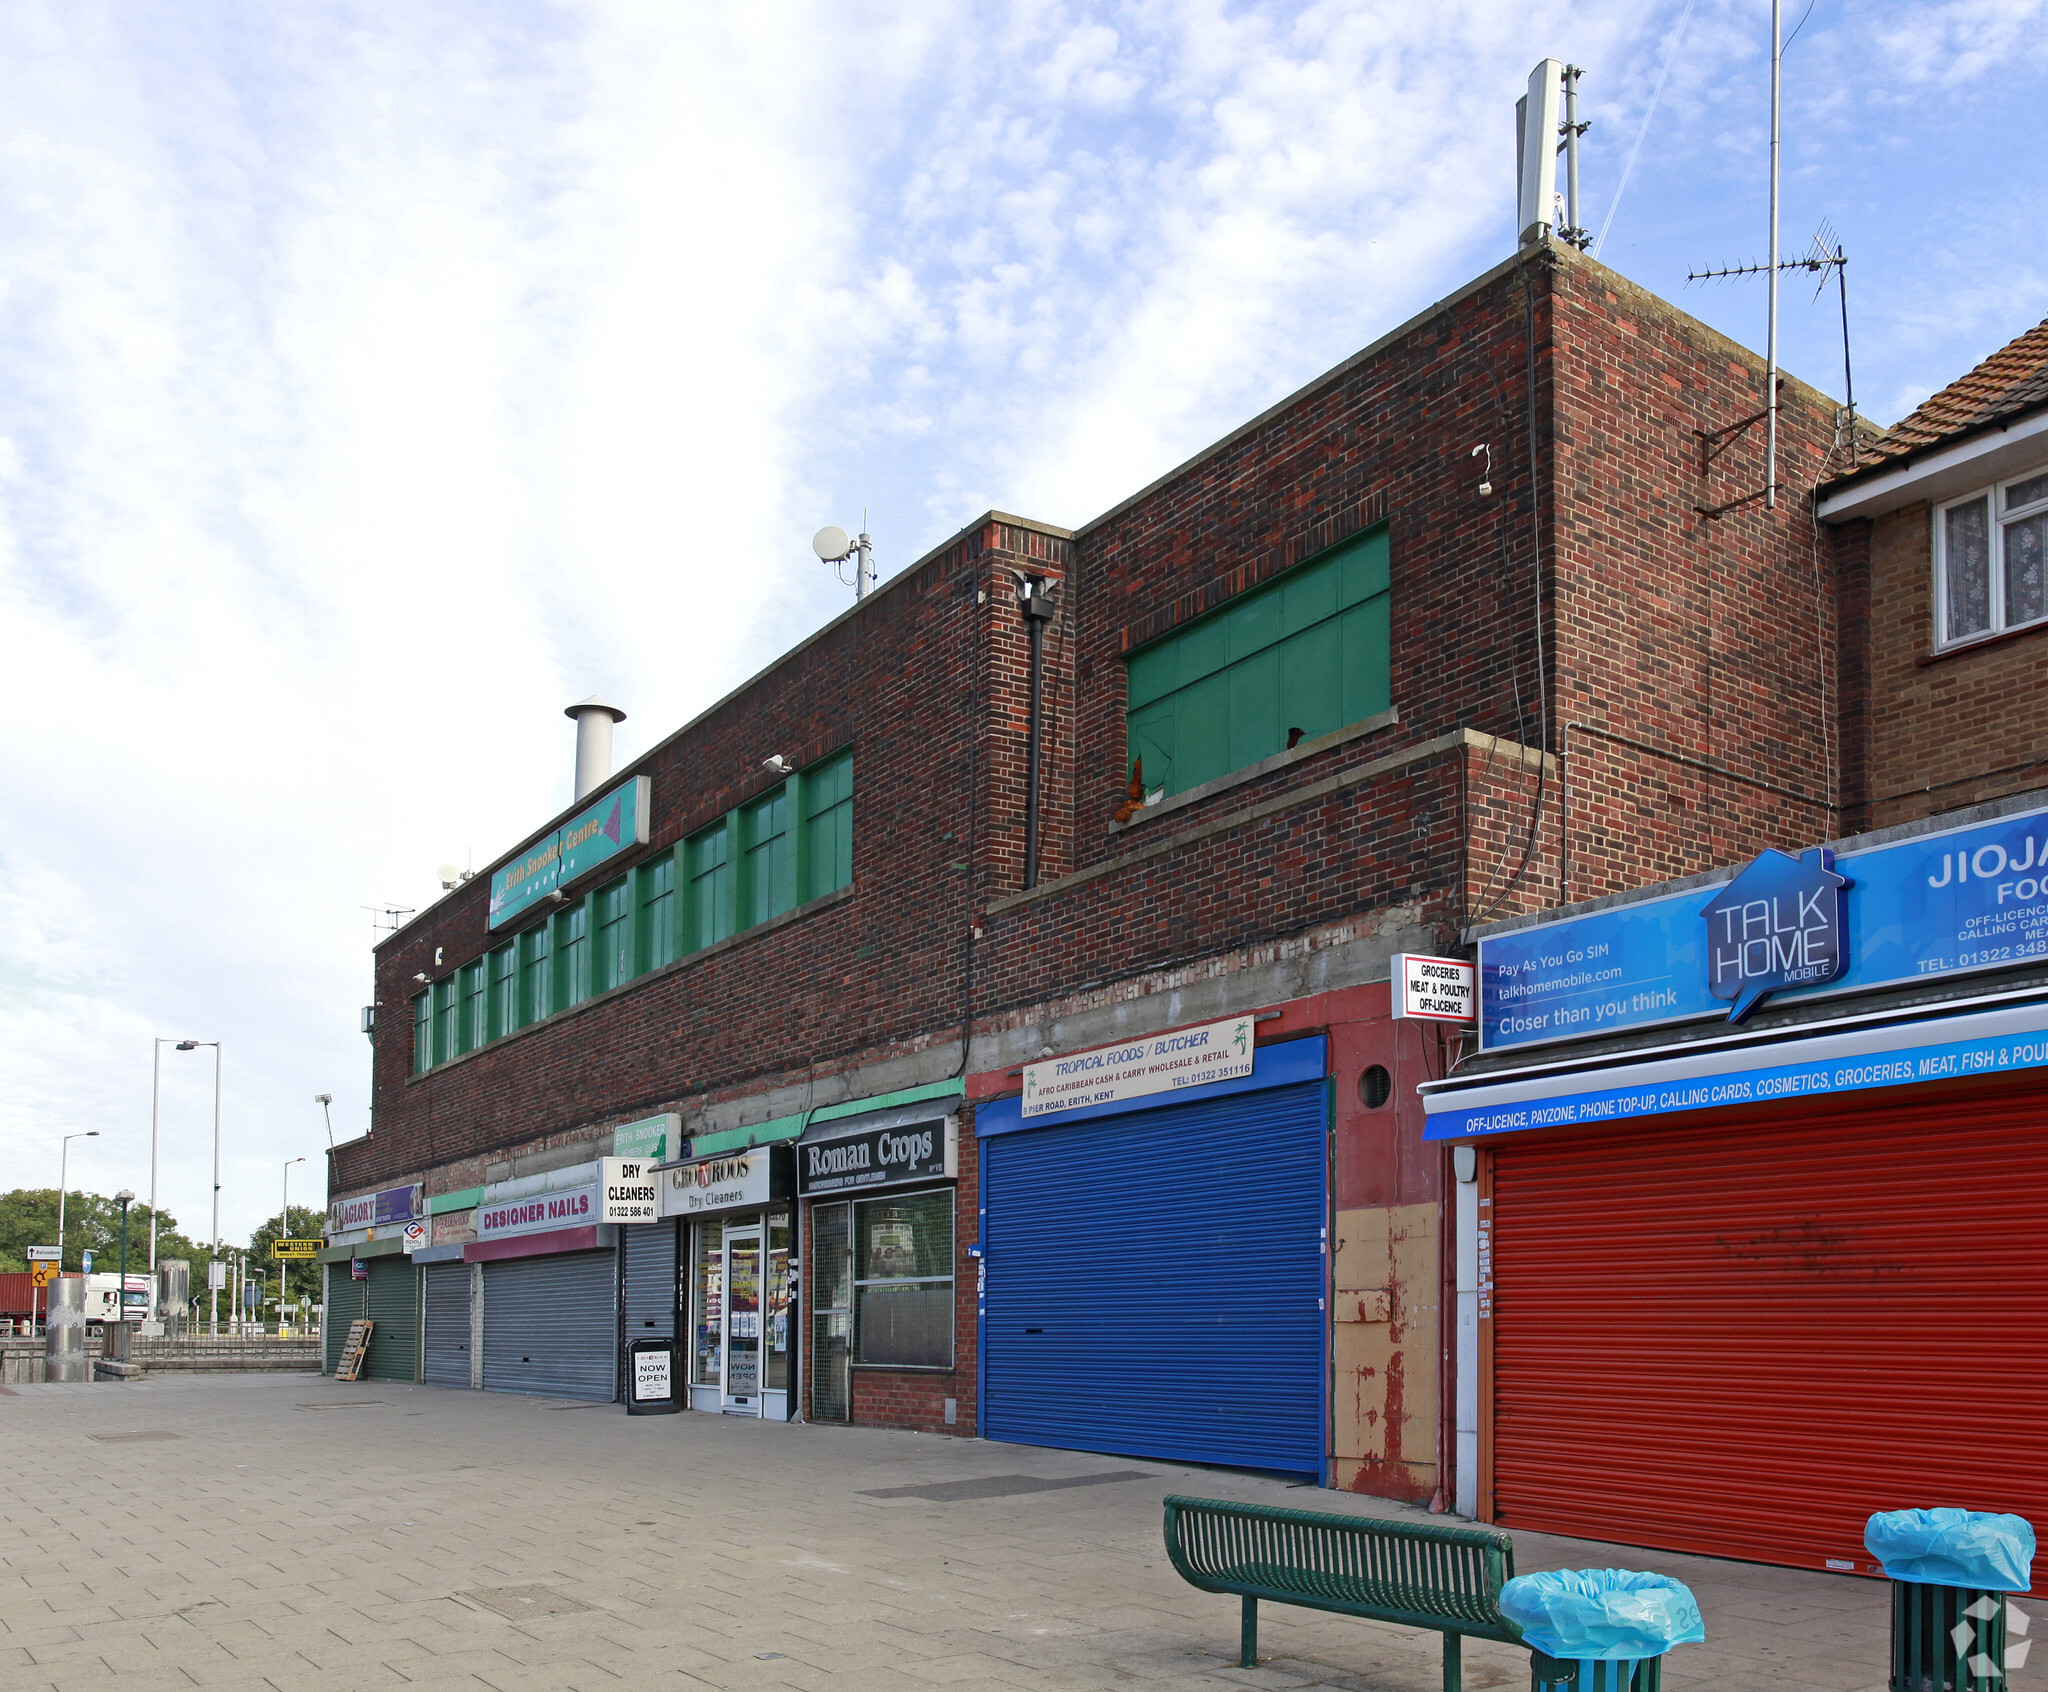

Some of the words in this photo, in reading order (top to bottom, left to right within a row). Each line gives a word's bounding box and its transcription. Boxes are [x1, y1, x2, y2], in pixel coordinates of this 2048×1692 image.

[506, 864, 526, 891] Erith
[527, 840, 564, 877] Snooker
[566, 819, 599, 851] Centre
[1715, 885, 1828, 943] TALK
[1965, 905, 2048, 928] OFF-LICENC
[1958, 923, 2016, 941] CALLING
[1499, 963, 1519, 977] Pay
[1522, 959, 1537, 972] As
[1540, 955, 1562, 968] You
[1566, 950, 1583, 963] Go
[1587, 943, 1609, 959] SIM
[1717, 925, 1829, 983] HOME
[1917, 957, 1954, 973] TEL:
[1959, 946, 2010, 966] 01322
[1421, 964, 1460, 980] GROCERIES
[1499, 967, 1622, 1000] talkhomemobile.com
[1784, 963, 1829, 982] MOBILE
[1411, 980, 1429, 993] MEAT
[1432, 982, 1437, 994] &
[1440, 983, 1470, 998] POULTRY
[1420, 998, 1462, 1014] OFF-LICENCE
[1500, 1014, 1549, 1035] Closer
[1554, 1006, 1590, 1026] than
[1596, 1000, 1627, 1021] you
[1632, 988, 1677, 1012] think
[1055, 1054, 1105, 1076] TROPICAL
[1106, 1046, 1144, 1066] FOODS
[1154, 1031, 1209, 1055] BUTCHER
[1038, 1086, 1055, 1097] AFRO
[1056, 1078, 1094, 1094] CARIBBEAN
[1095, 1074, 1114, 1085] CASH
[1122, 1067, 1146, 1079] CARRY
[1148, 1057, 1193, 1074] WHOLESALE
[1194, 1056, 1200, 1065] &
[1202, 1049, 1230, 1063] RETAIL
[1172, 1076, 1190, 1087] TEL:
[1191, 1070, 1216, 1083] 01322
[1218, 1063, 1250, 1078] 351116
[1466, 1111, 1529, 1133] OFF-LICENCE,
[1530, 1105, 1577, 1125] PAYZONE,
[1579, 1099, 1616, 1119] PHONE
[1617, 1094, 1657, 1114] TOP-UP,
[1660, 1086, 1709, 1108] CALLING
[1711, 1081, 1753, 1101] CARDS,
[1756, 1071, 1831, 1096] COSMETICS,
[1834, 1061, 1914, 1087] GROCERIES,
[1918, 1055, 1957, 1076] MEAT,
[1961, 1049, 1995, 1070] FISH
[1998, 1048, 2009, 1065] &
[2012, 1042, 2048, 1064] POU
[1029, 1104, 1044, 1114] PIER
[1045, 1100, 1067, 1112] ROAD,
[1068, 1094, 1093, 1107] ERITH,
[1094, 1090, 1115, 1101] KENT
[616, 1132, 633, 1146] ERITH
[636, 1123, 666, 1141] SNOOKER
[808, 1142, 871, 1177] Roman
[877, 1131, 933, 1171] Crops
[622, 1164, 640, 1179] DRY
[844, 1176, 855, 1185] FOR
[855, 1171, 886, 1184] GENTLEMEN
[608, 1186, 655, 1201] CLEANERS
[689, 1194, 702, 1209] Dry
[705, 1190, 743, 1205] Cleaners
[484, 1203, 545, 1230] DESIGNER
[548, 1194, 589, 1219] NAILS
[609, 1207, 628, 1217] 01322
[630, 1206, 642, 1216] 586
[643, 1206, 654, 1217] 401
[638, 1374, 668, 1382] OPEN
[640, 1364, 666, 1372] NOW
